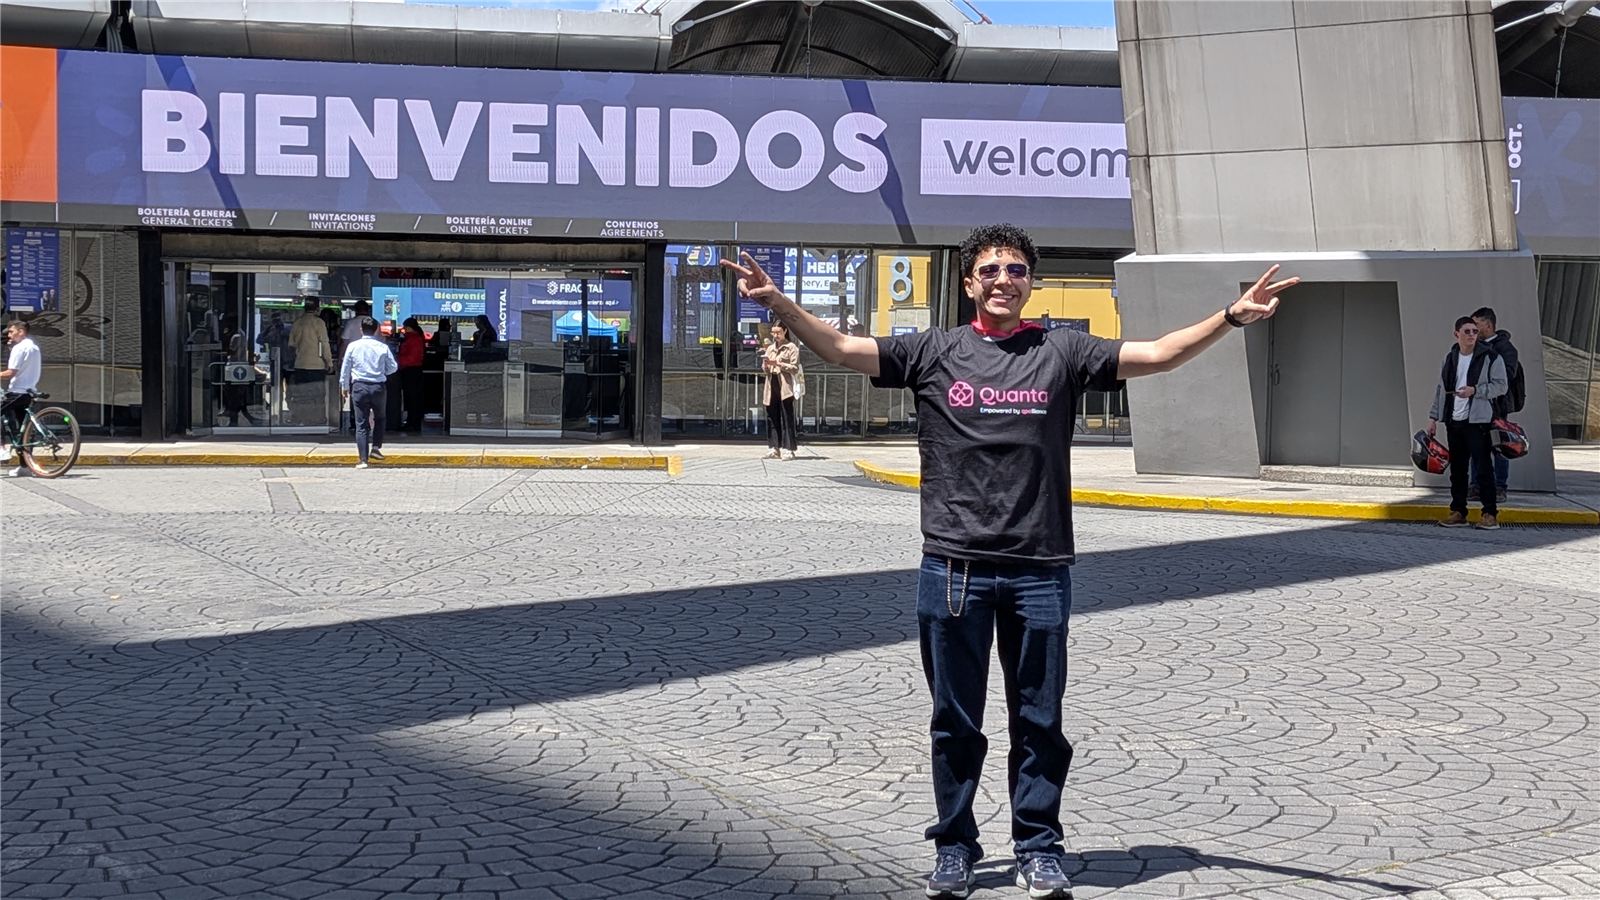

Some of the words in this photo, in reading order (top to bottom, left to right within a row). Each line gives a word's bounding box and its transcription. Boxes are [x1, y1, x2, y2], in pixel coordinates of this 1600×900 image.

[142, 89, 888, 193] BIENVENIDOS
[1508, 123, 1522, 168] OCT.
[943, 138, 1128, 178] Welcom
[138, 207, 190, 217] BOLETERÍA
[194, 209, 237, 218] GENERAL
[309, 213, 376, 222] INVITACIONES
[142, 217, 190, 226] GENERAL
[192, 218, 233, 227] TICKETS
[311, 221, 374, 231] INVITATIONS
[446, 216, 496, 225] BOLETERÍA
[499, 218, 533, 226] ONLINE
[605, 221, 659, 229] CONVENIOS
[450, 225, 487, 234] ONLINE
[490, 226, 529, 235] TICKETS
[600, 229, 664, 238] AGREEMENTS
[559, 283, 603, 293] FRACTAL
[434, 292, 485, 300] Bienvenid
[979, 387, 1048, 405] Quanta
[1013, 407, 1020, 415] by
